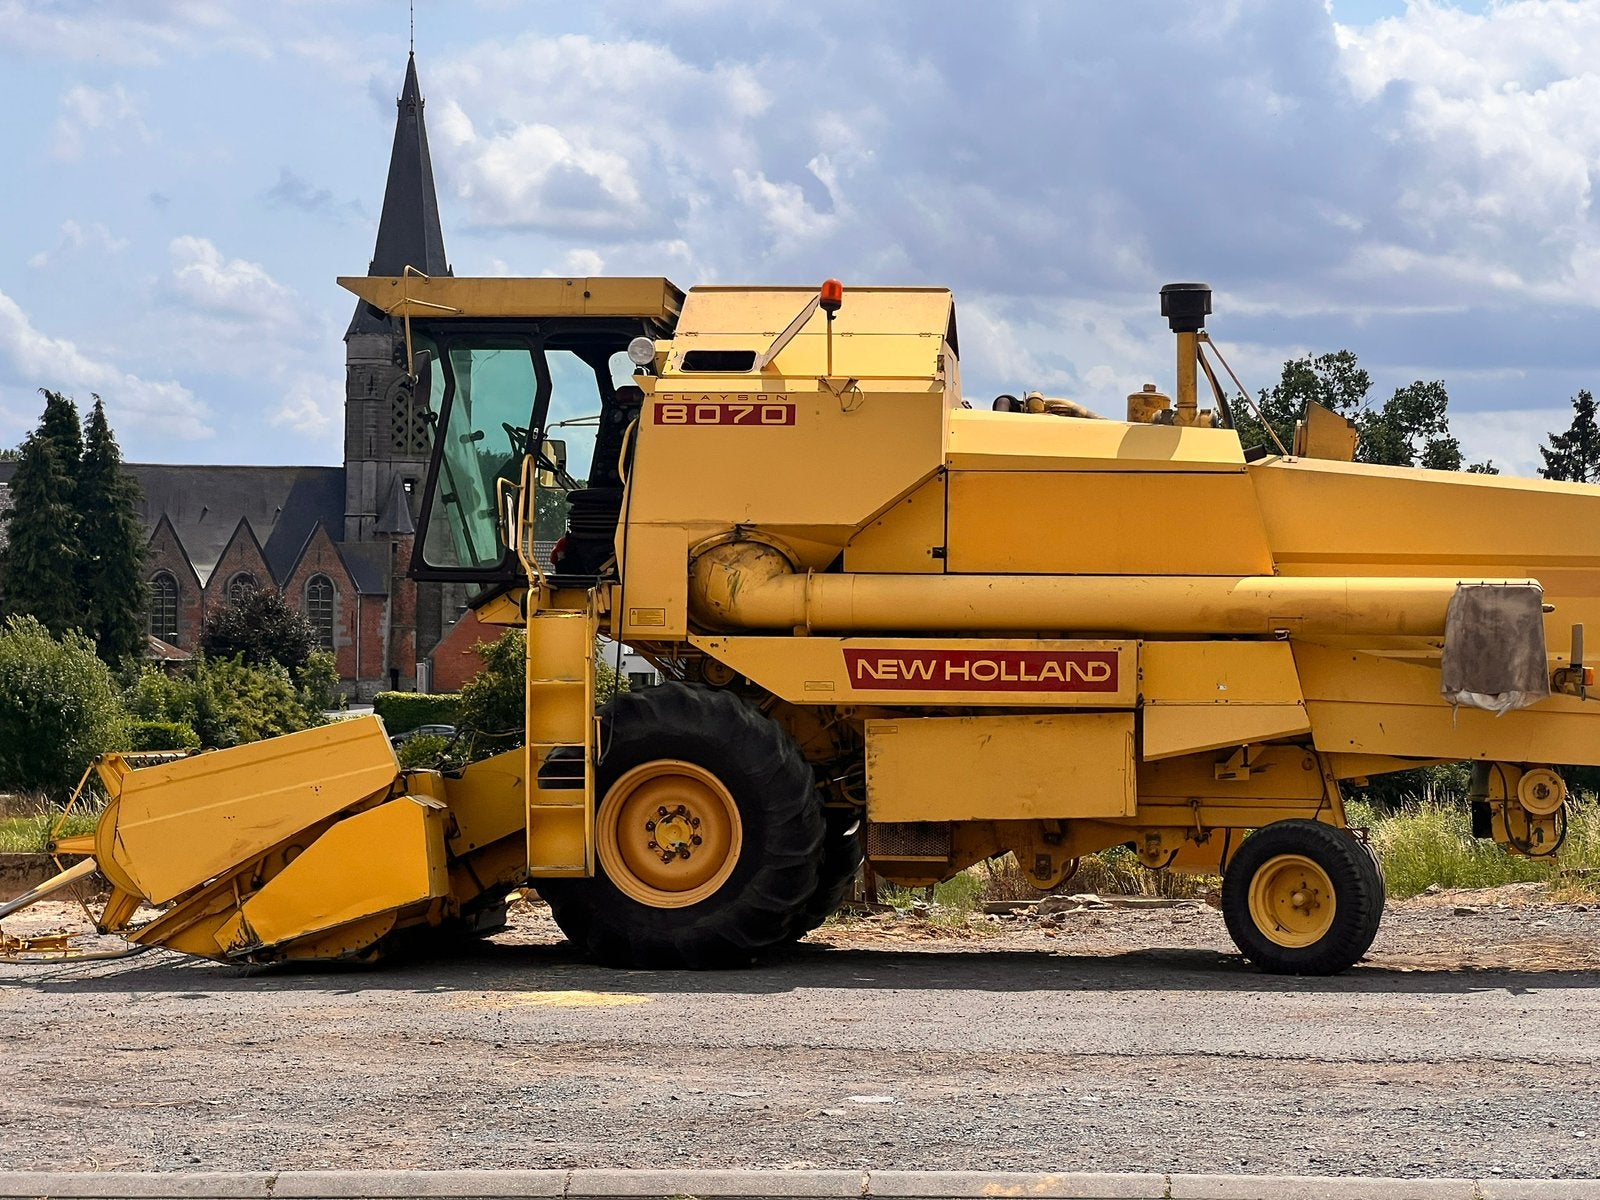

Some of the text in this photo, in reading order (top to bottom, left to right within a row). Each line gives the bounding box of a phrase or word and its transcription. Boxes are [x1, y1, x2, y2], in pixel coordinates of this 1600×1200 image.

[662, 405, 787, 424] 8070
[857, 658, 1111, 682] NEW HOLLAND
